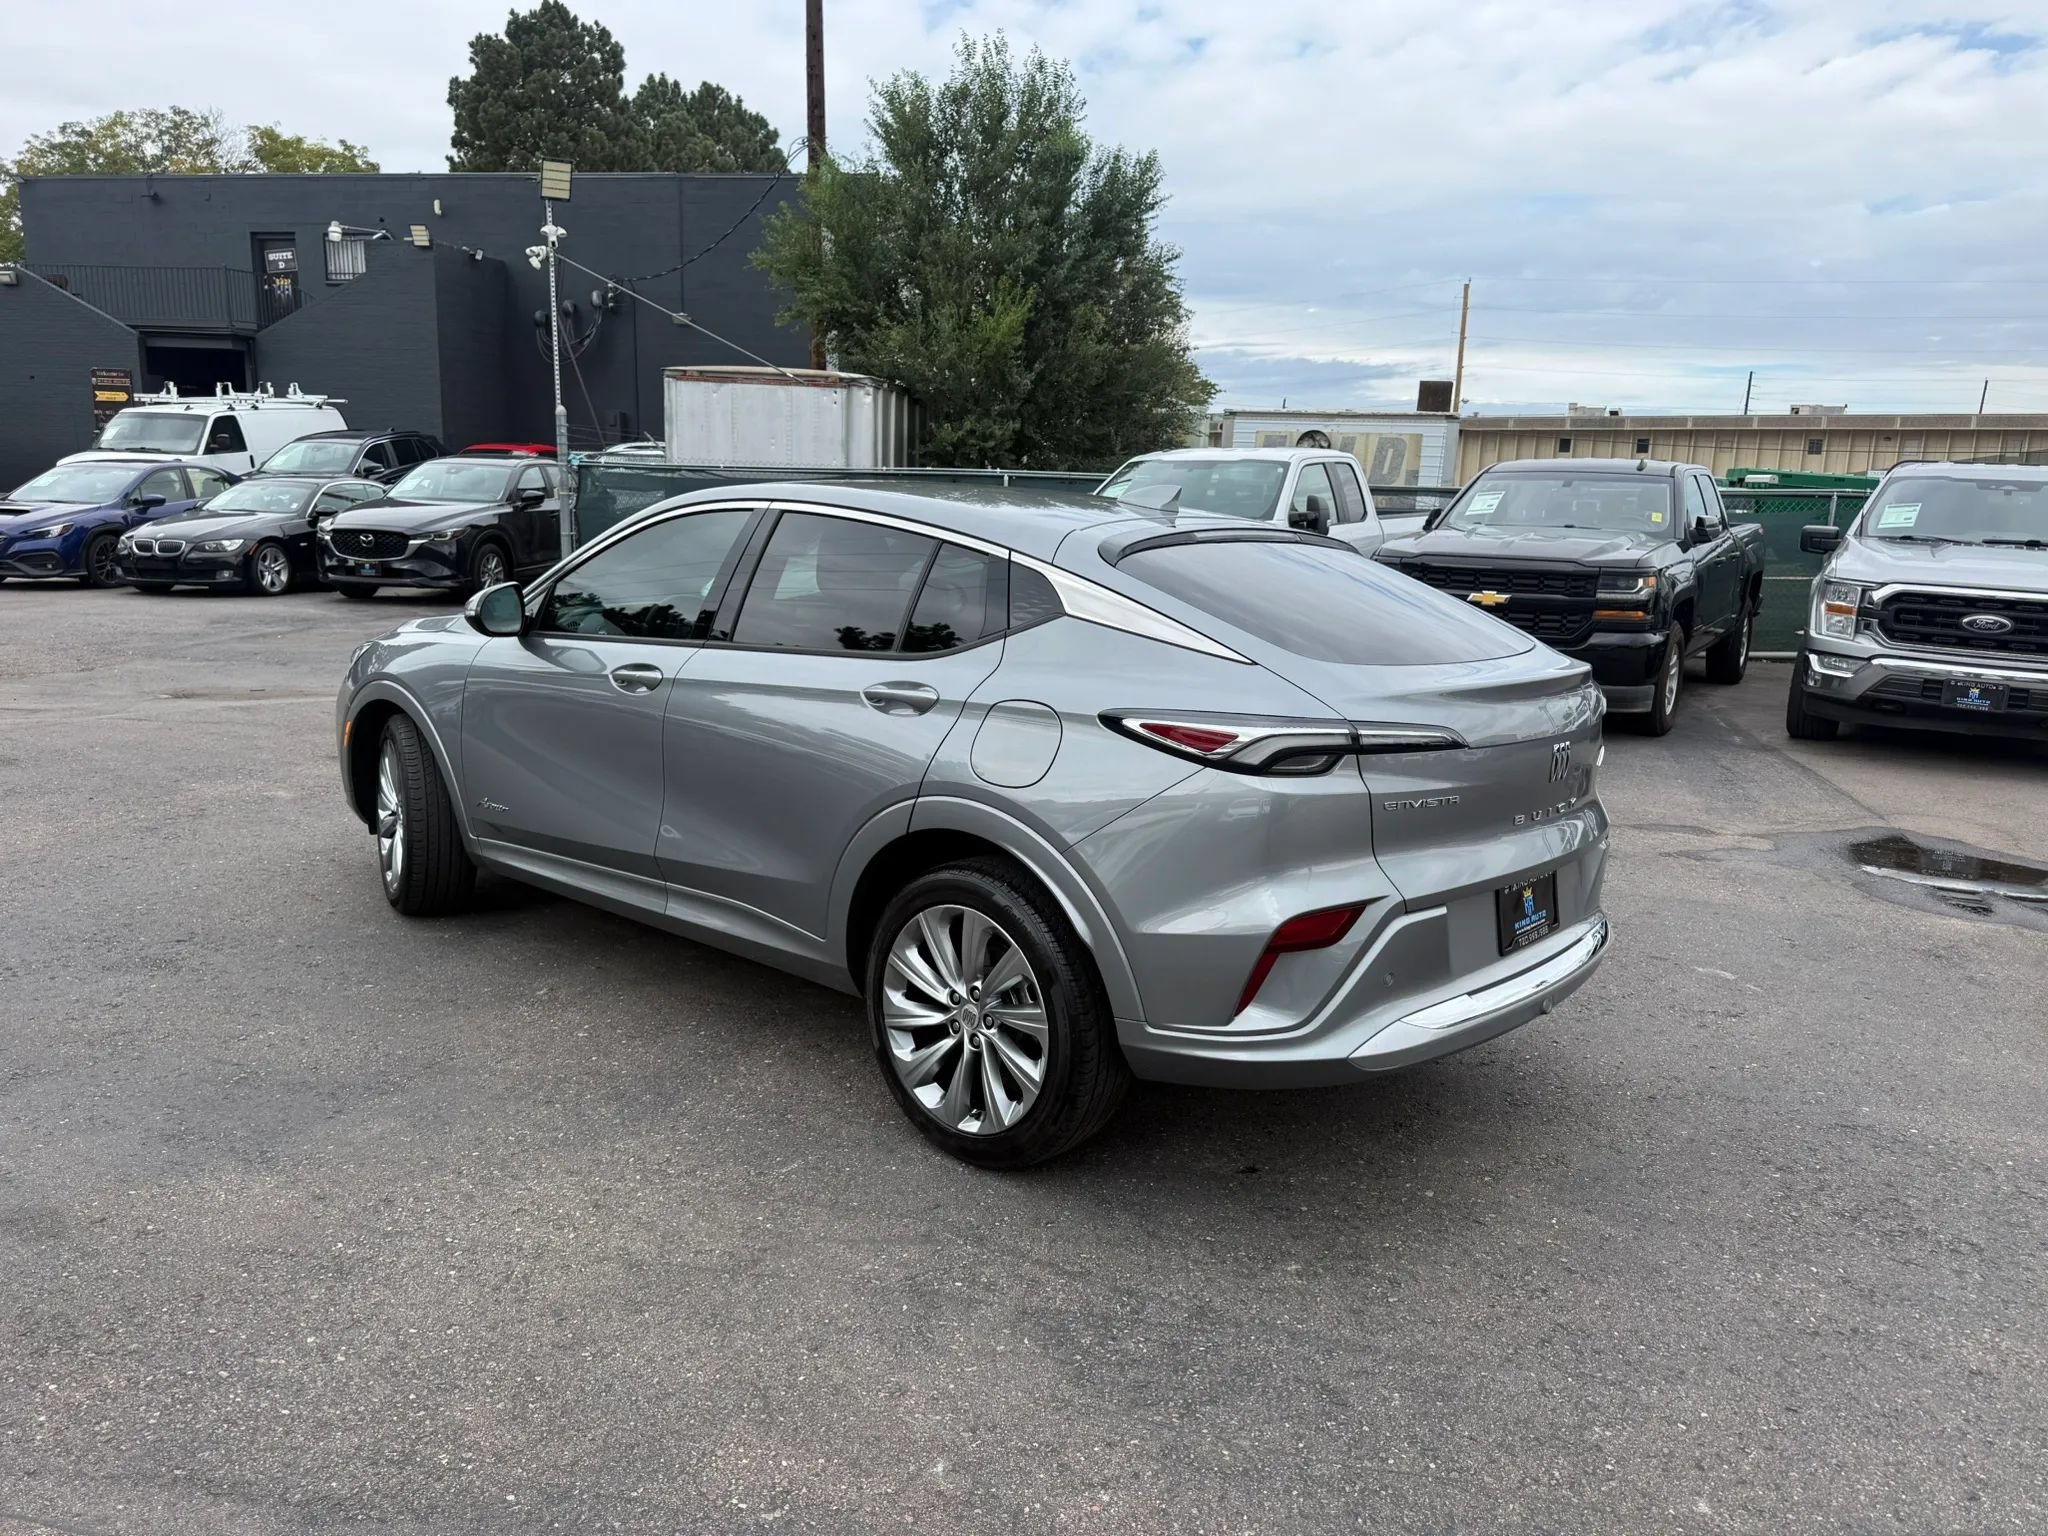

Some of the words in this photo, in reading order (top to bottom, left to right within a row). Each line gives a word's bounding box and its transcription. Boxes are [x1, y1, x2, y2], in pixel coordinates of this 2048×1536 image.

[268, 251, 293, 260] SUITE
[278, 261, 285, 269] D
[1973, 618, 2000, 629] Ford
[1384, 796, 1460, 811] ENVISTA
[1514, 797, 1577, 825] BUICK
[1514, 916, 1531, 930] KING
